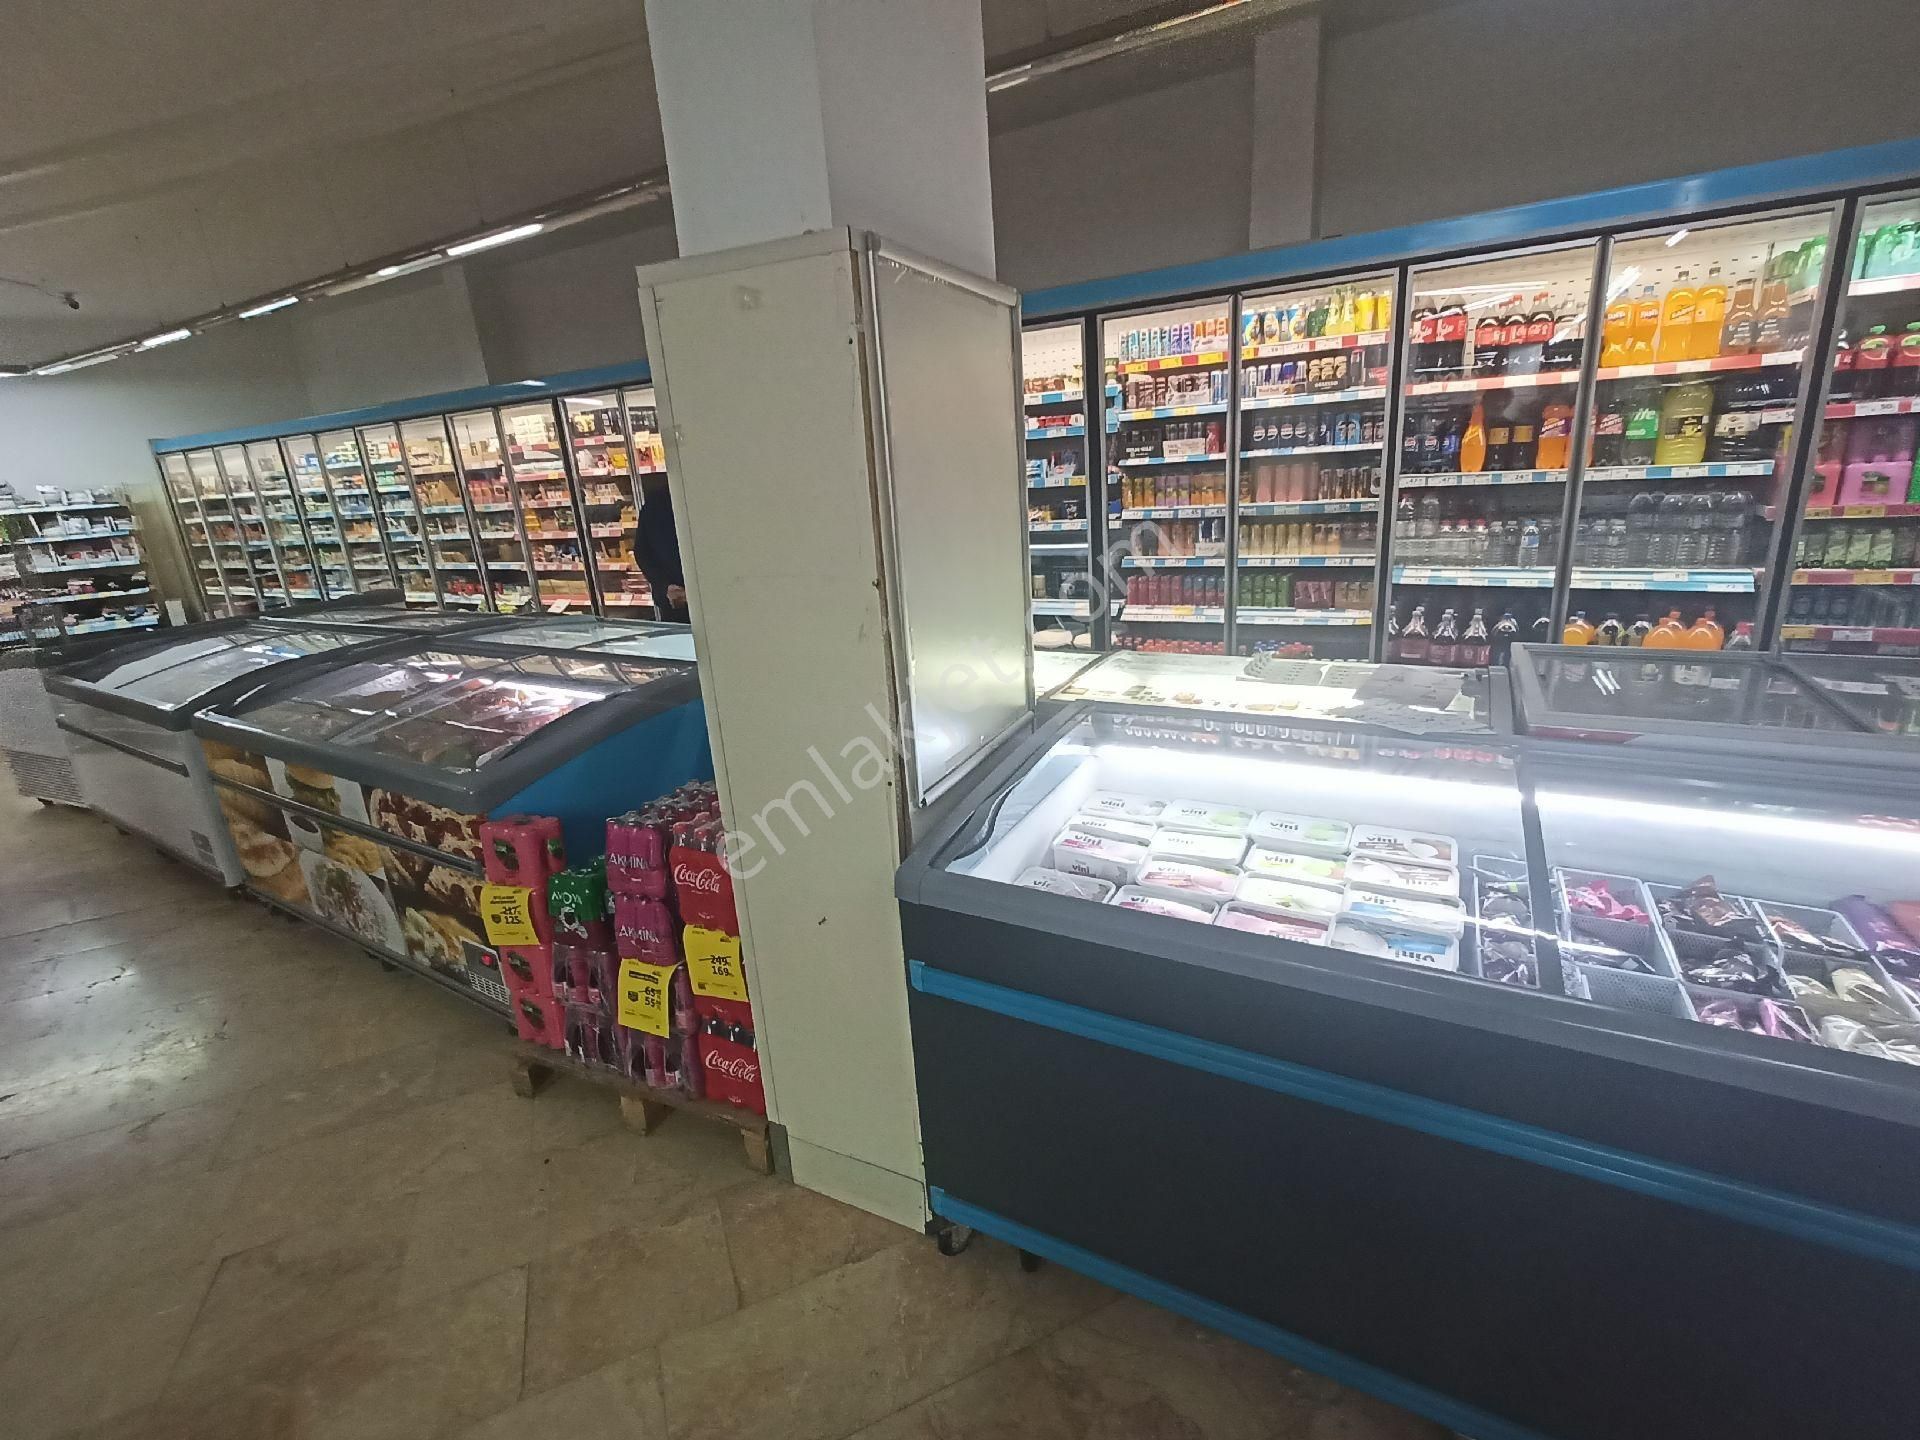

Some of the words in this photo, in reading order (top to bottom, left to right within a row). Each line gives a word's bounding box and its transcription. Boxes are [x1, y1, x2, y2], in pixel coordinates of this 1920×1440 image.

[1270, 821, 1299, 831] vini
[1074, 833, 1104, 847] vini
[1072, 862, 1090, 874] vini
[674, 863, 723, 893] Coca-Cola
[705, 1050, 759, 1083] Coca-Cola
